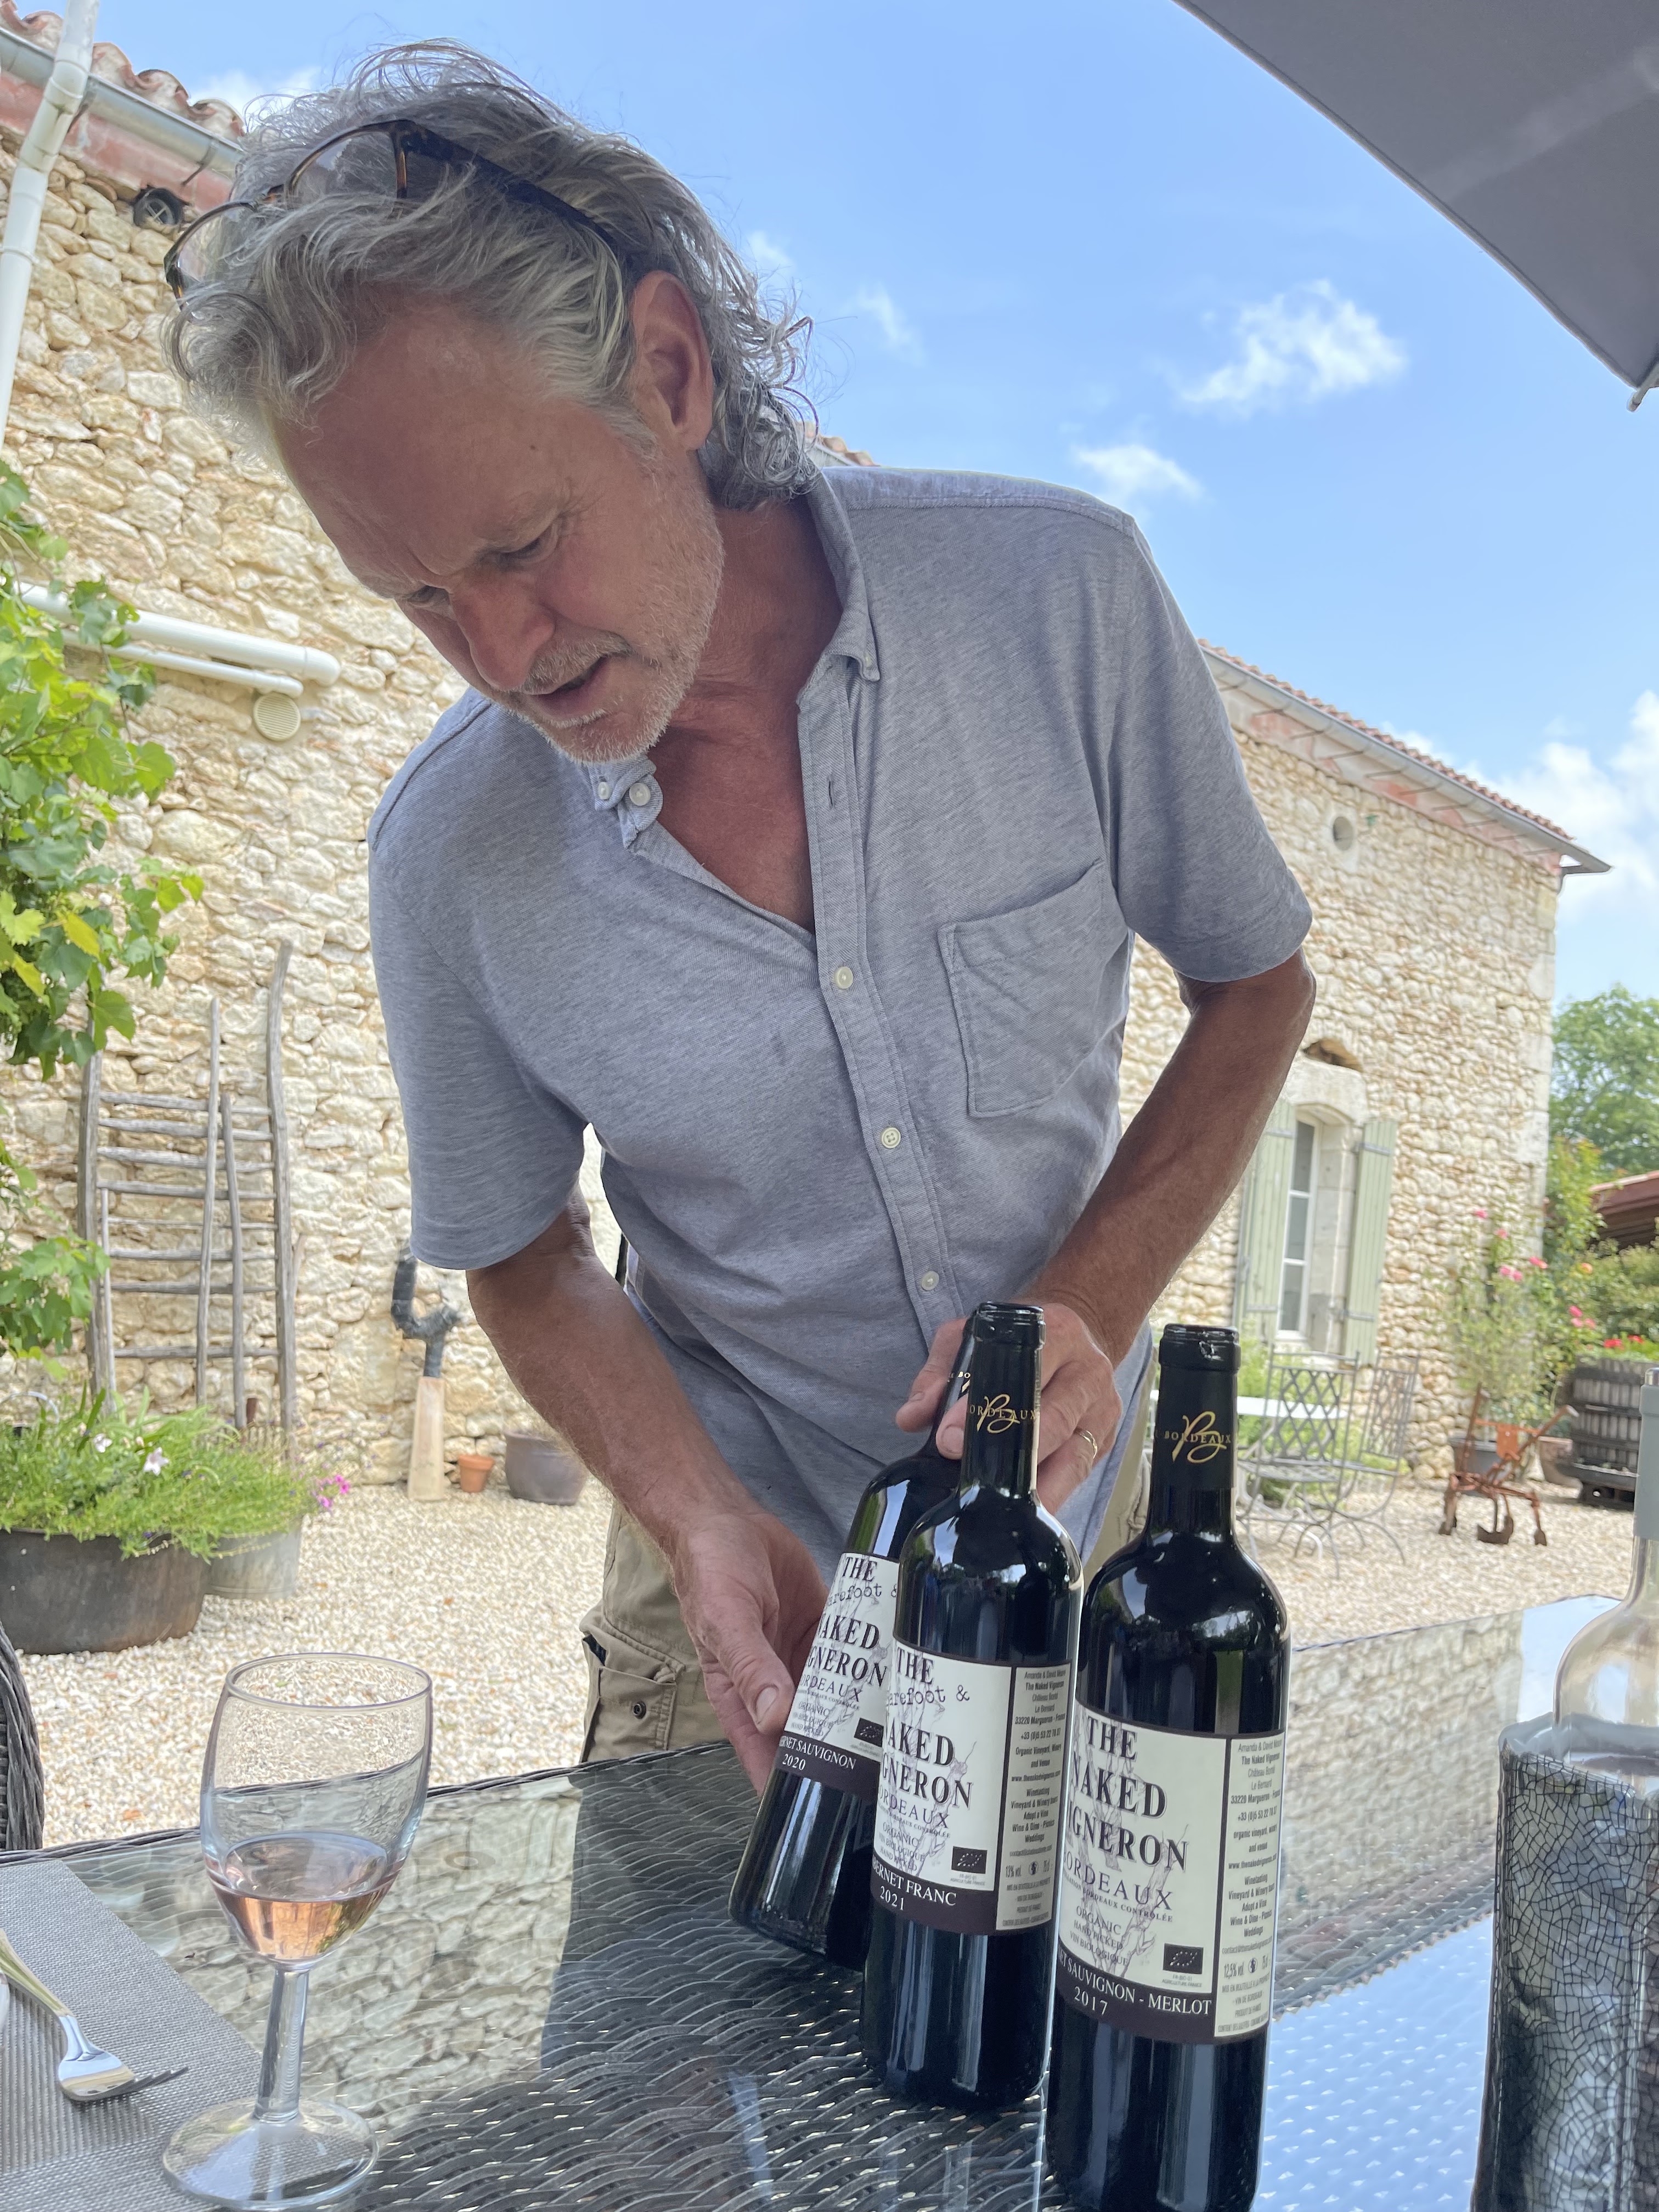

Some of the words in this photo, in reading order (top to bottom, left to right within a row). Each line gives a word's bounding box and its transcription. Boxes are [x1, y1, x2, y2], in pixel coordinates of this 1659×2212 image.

[970, 1405, 1036, 1420] ORDEAUX
[1164, 1431, 1231, 1443] BORDEAUX
[842, 1557, 877, 1582] THE
[826, 1583, 882, 1606] arefoot
[808, 1646, 887, 1688] GNERON
[898, 1647, 934, 1685] THE
[800, 1674, 862, 1702] ORDEAUX
[887, 1686, 945, 1706] arefoot
[956, 1685, 970, 1701] &
[1035, 1681, 1048, 1690] Naked
[887, 1717, 955, 1765] AKED
[1021, 1731, 1029, 1740] +33
[1087, 1716, 1137, 1760] THE
[782, 1753, 806, 1770] 2020
[796, 1740, 856, 1769] SAUVIGNON
[1242, 1756, 1250, 1764] The
[1251, 1754, 1265, 1764] Naked
[882, 1753, 973, 1809] GNERON
[1251, 1782, 1256, 1790] Le
[879, 1787, 950, 1828] ORDEAUX
[1011, 1800, 1031, 1810] Vineyard
[1231, 1795, 1246, 1804] 33220
[1238, 1812, 1246, 1821] +33
[1248, 1811, 1257, 1822] (0)5
[1258, 1810, 1263, 1819] 53
[1263, 1809, 1268, 1818] 22
[883, 1822, 919, 1847] ORGANIC
[1012, 1824, 1024, 1832] Wine
[1069, 1802, 1188, 1872] IGNERON
[1234, 1829, 1250, 1840] organic
[880, 1886, 904, 1910] 2021
[906, 1880, 957, 1906] FRANC
[1229, 1889, 1249, 1900] Vineyard
[1251, 1888, 1254, 1897] &
[1242, 1901, 1255, 1912] Adopt
[1076, 1905, 1122, 1935] ORGANIC
[1231, 1917, 1243, 1926] Wine
[1244, 1915, 1248, 1924] &
[1244, 1926, 1263, 1937] Weddings
[1074, 1920, 1091, 1936] HAND
[1093, 1931, 1123, 1949] PICKED
[1070, 1930, 1079, 1944] VIN
[1080, 1938, 1128, 1966] BIOLOGIQUE
[1068, 1957, 1136, 2004] SAUVIGNON
[1148, 1993, 1212, 2015] MERLOT
[1074, 1986, 1108, 2016] 2017
